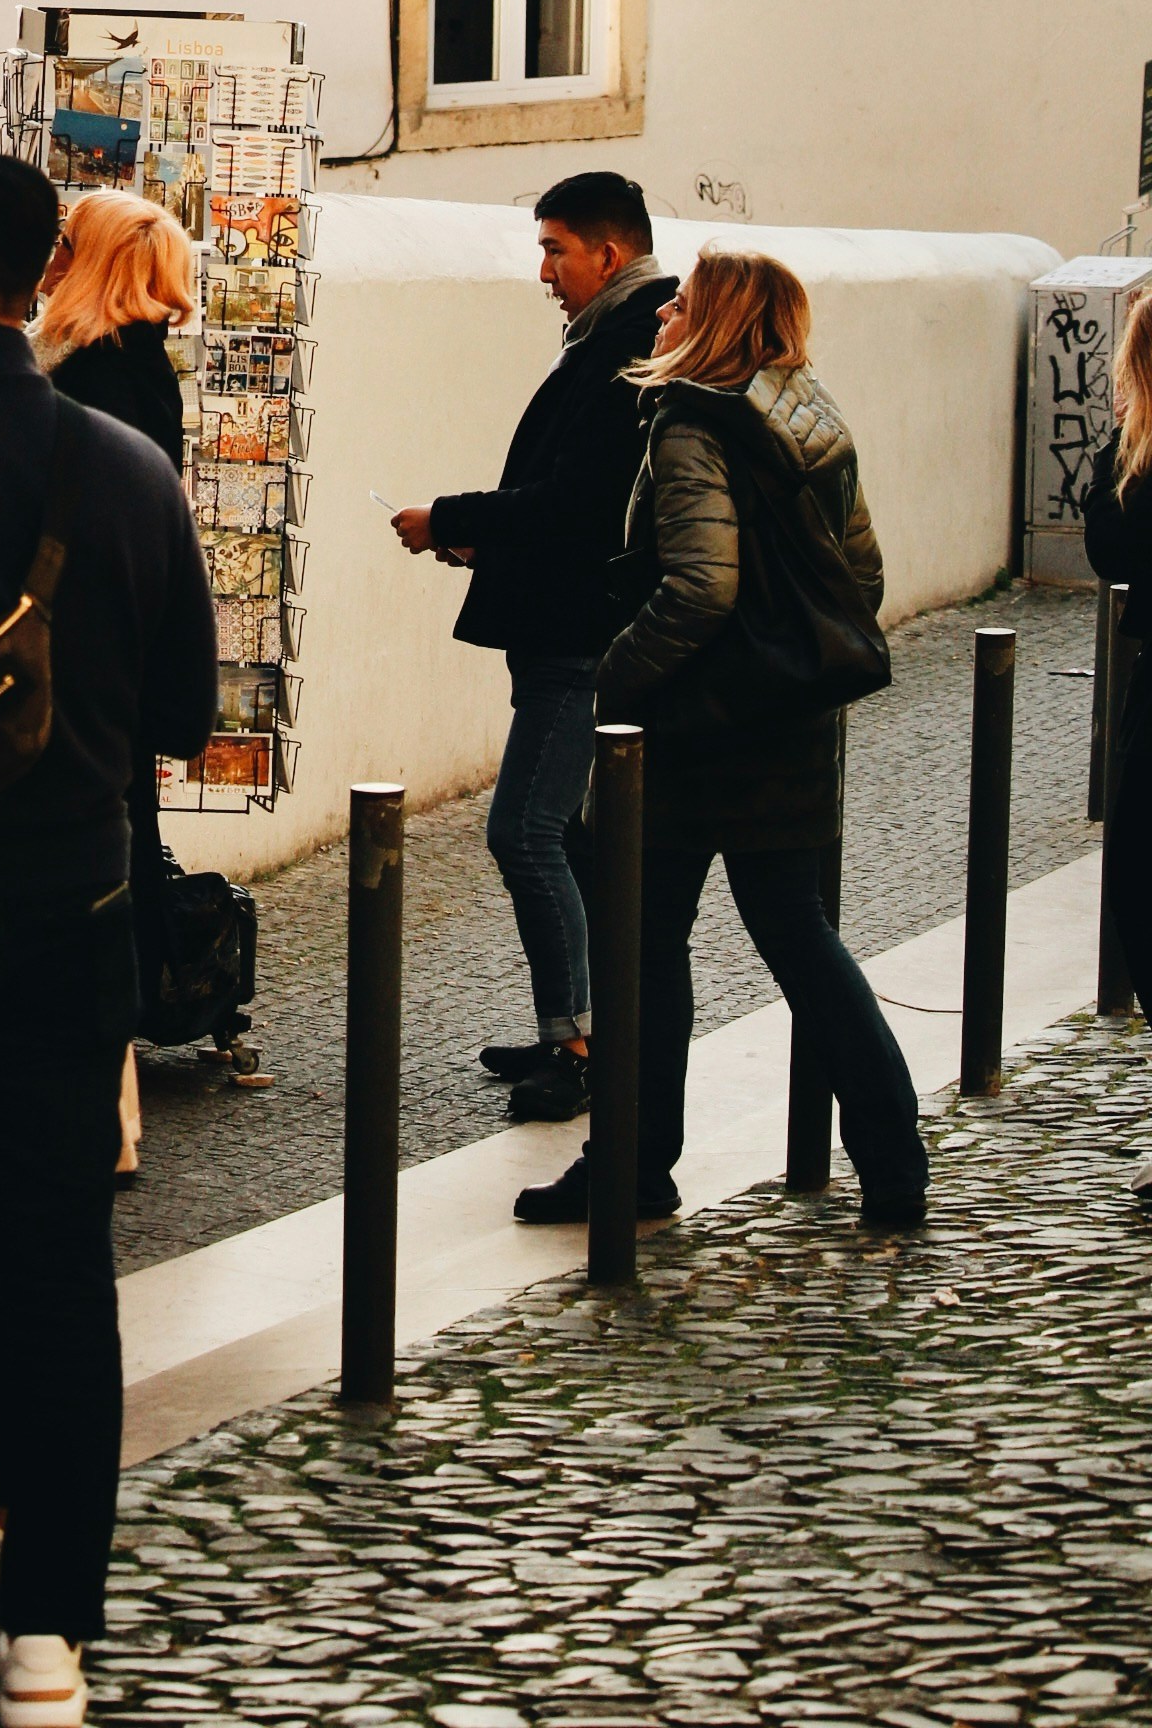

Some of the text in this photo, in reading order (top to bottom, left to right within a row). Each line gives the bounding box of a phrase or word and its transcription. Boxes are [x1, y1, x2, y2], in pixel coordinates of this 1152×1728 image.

[166, 39, 224, 56] Lisboa
[230, 354, 247, 363] LIS
[229, 363, 247, 373] BOA
